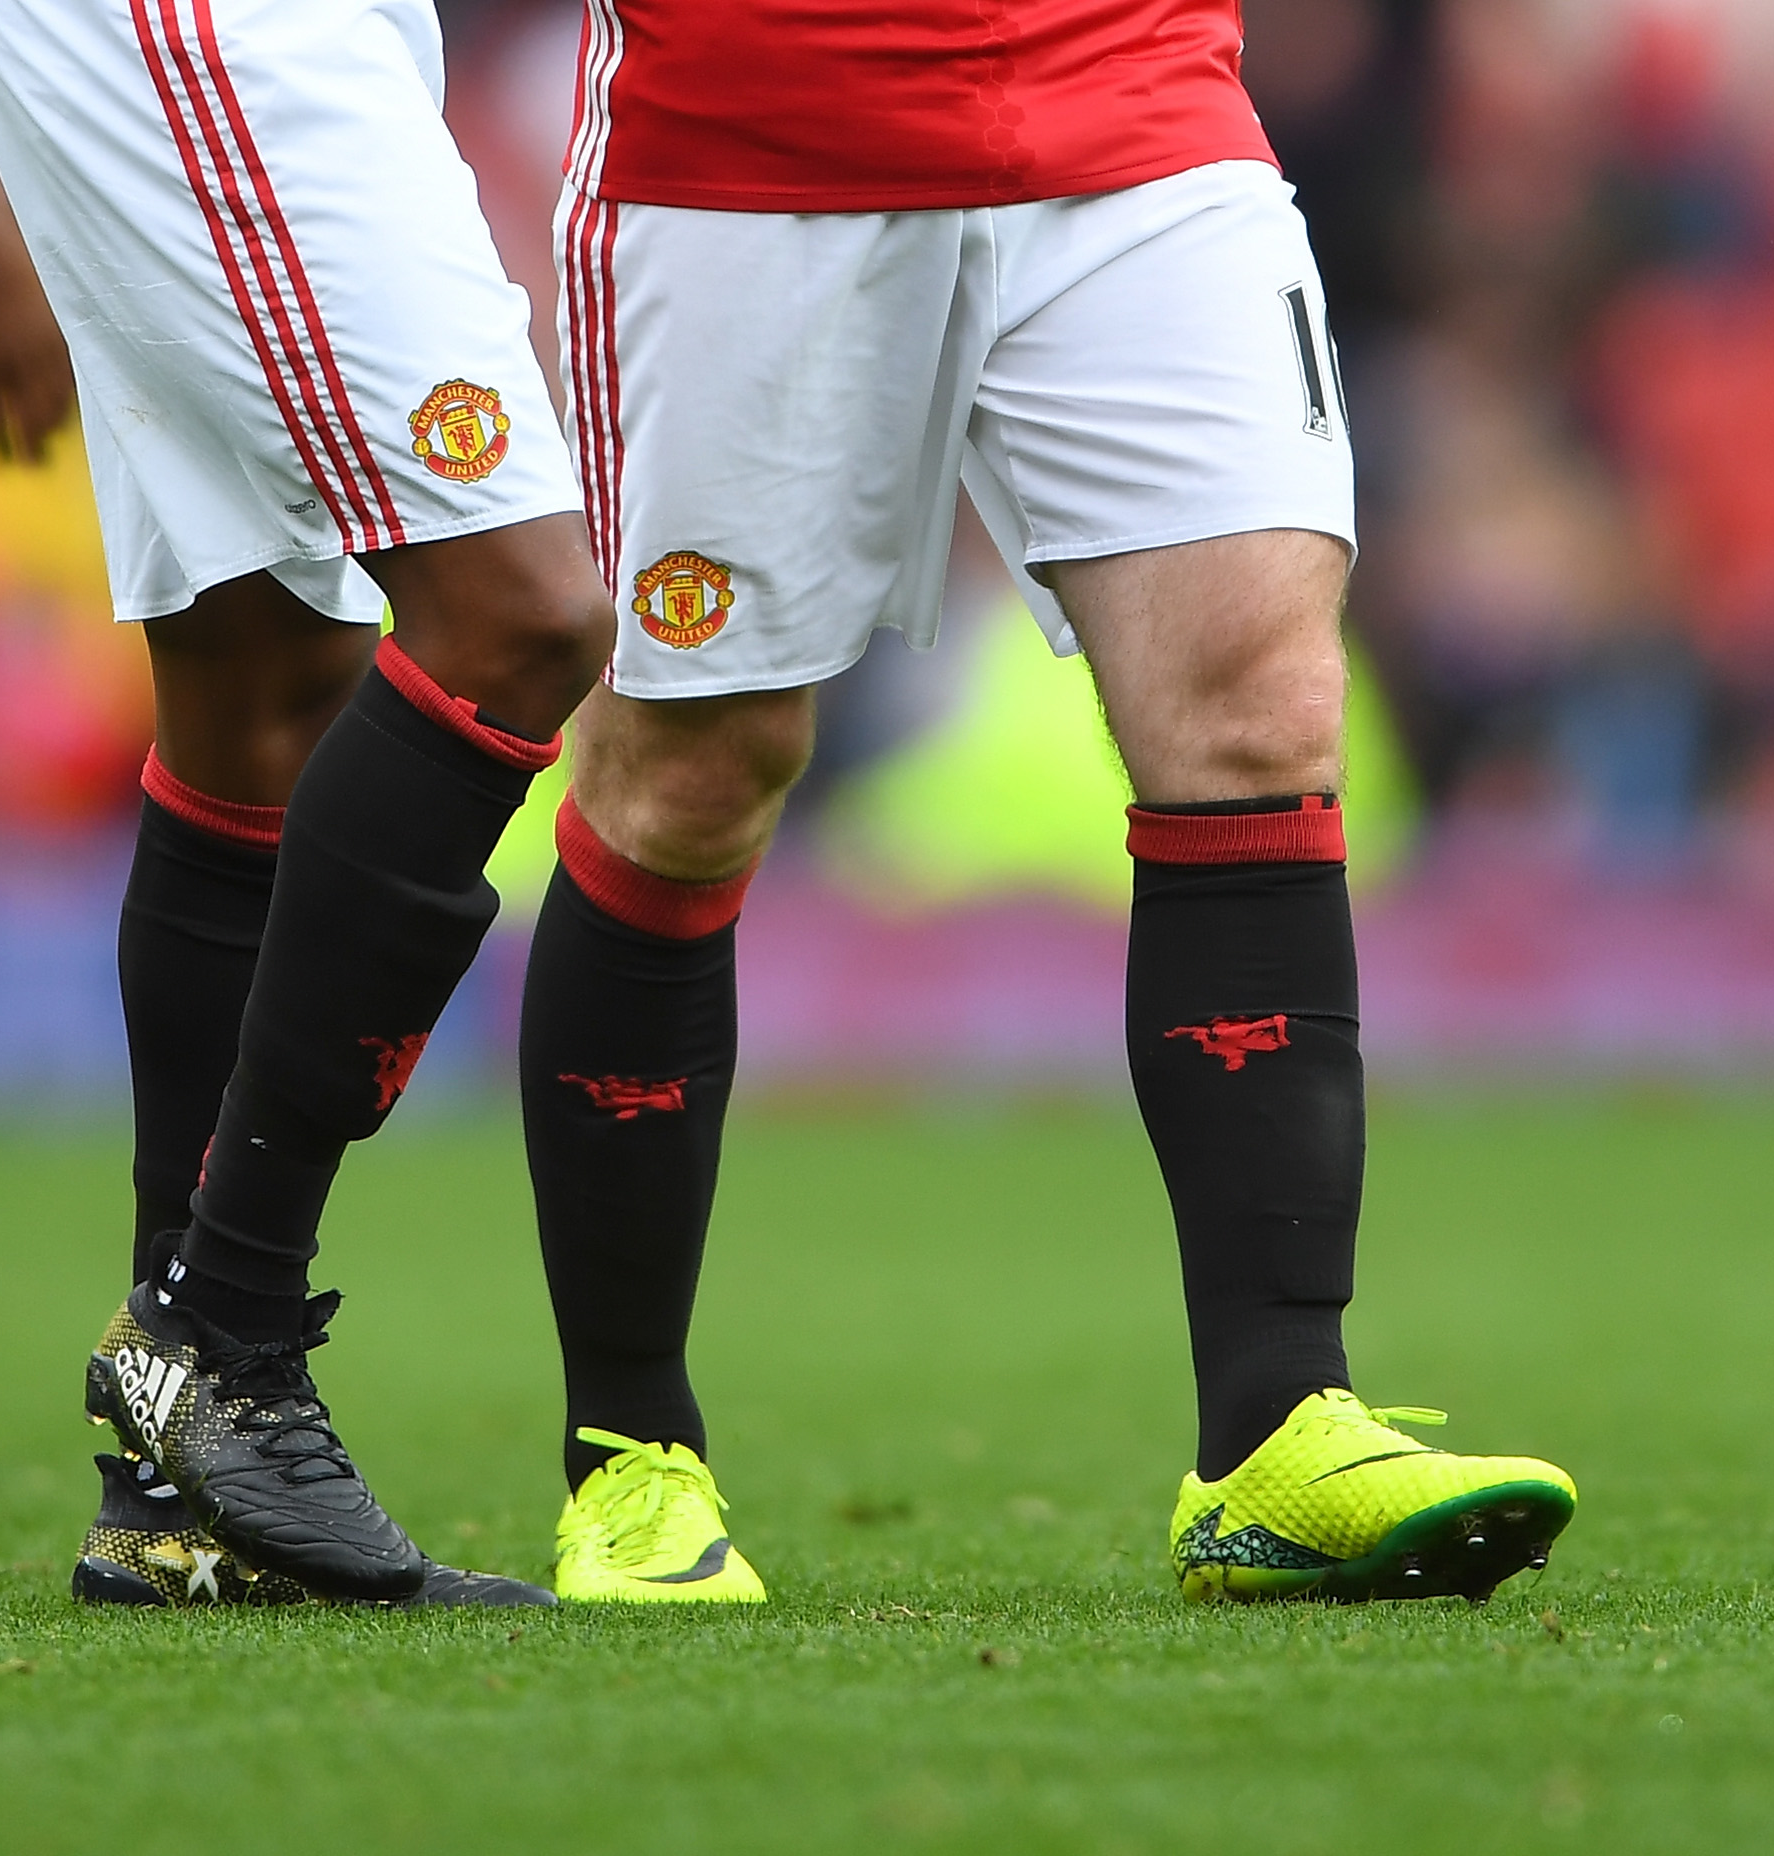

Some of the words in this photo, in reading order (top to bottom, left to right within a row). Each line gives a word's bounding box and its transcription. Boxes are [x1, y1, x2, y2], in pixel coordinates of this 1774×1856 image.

[1277, 279, 1351, 442] 1
[417, 385, 495, 430] MANCHESTER
[445, 449, 499, 476] UNITED
[641, 556, 722, 589] MANCHESTER
[657, 621, 714, 641] UNITED
[114, 1344, 165, 1465] adidas
